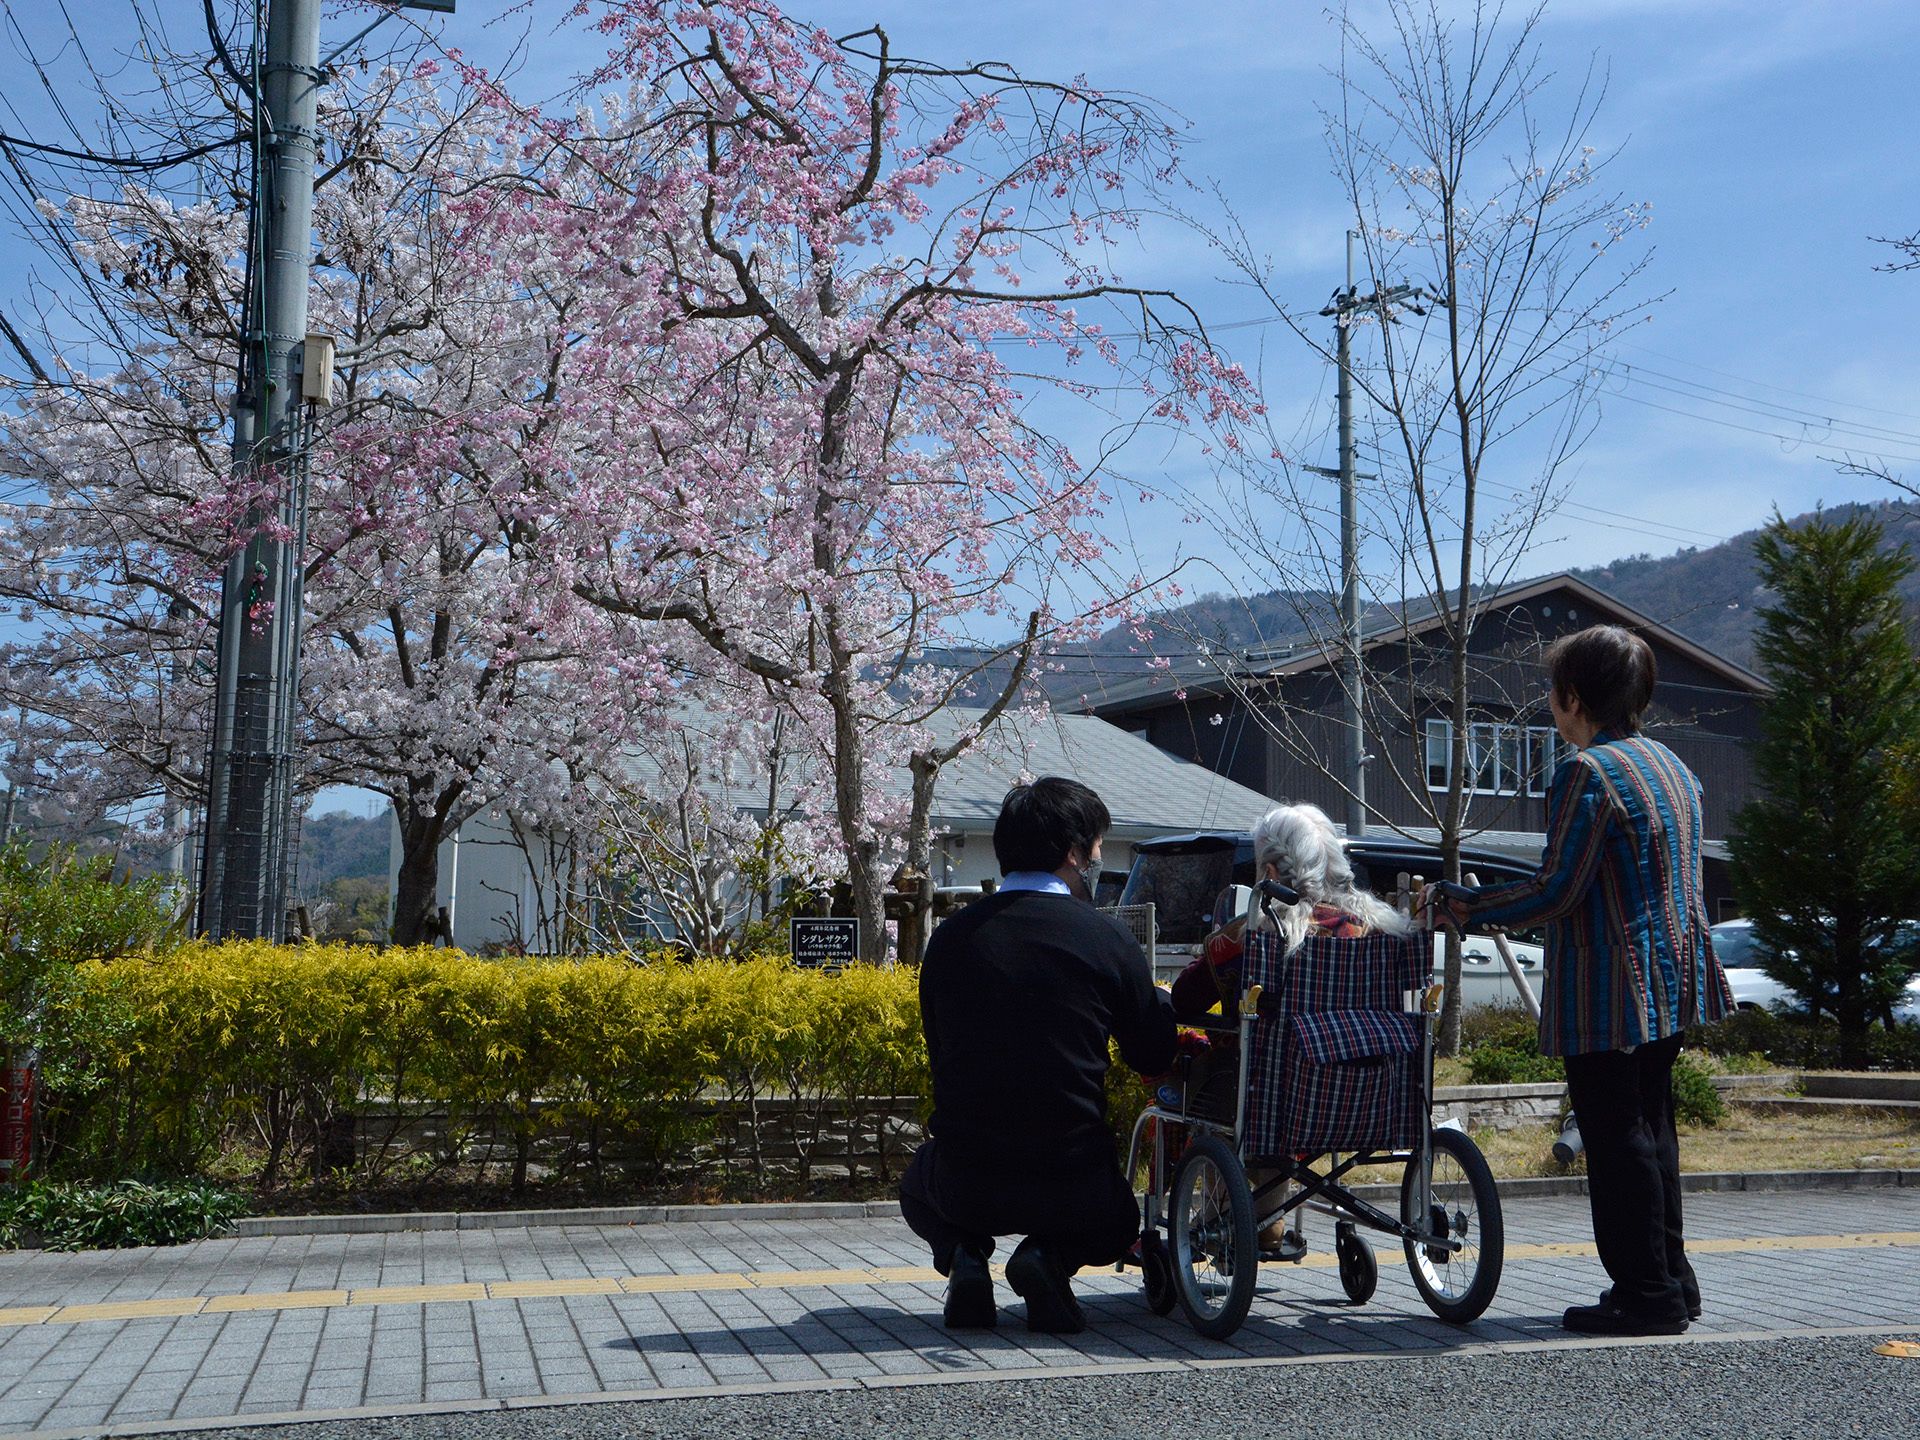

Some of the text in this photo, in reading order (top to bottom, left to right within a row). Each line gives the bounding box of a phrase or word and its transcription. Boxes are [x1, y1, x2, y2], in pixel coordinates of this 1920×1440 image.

[801, 934, 849, 944] シダレザクラ
